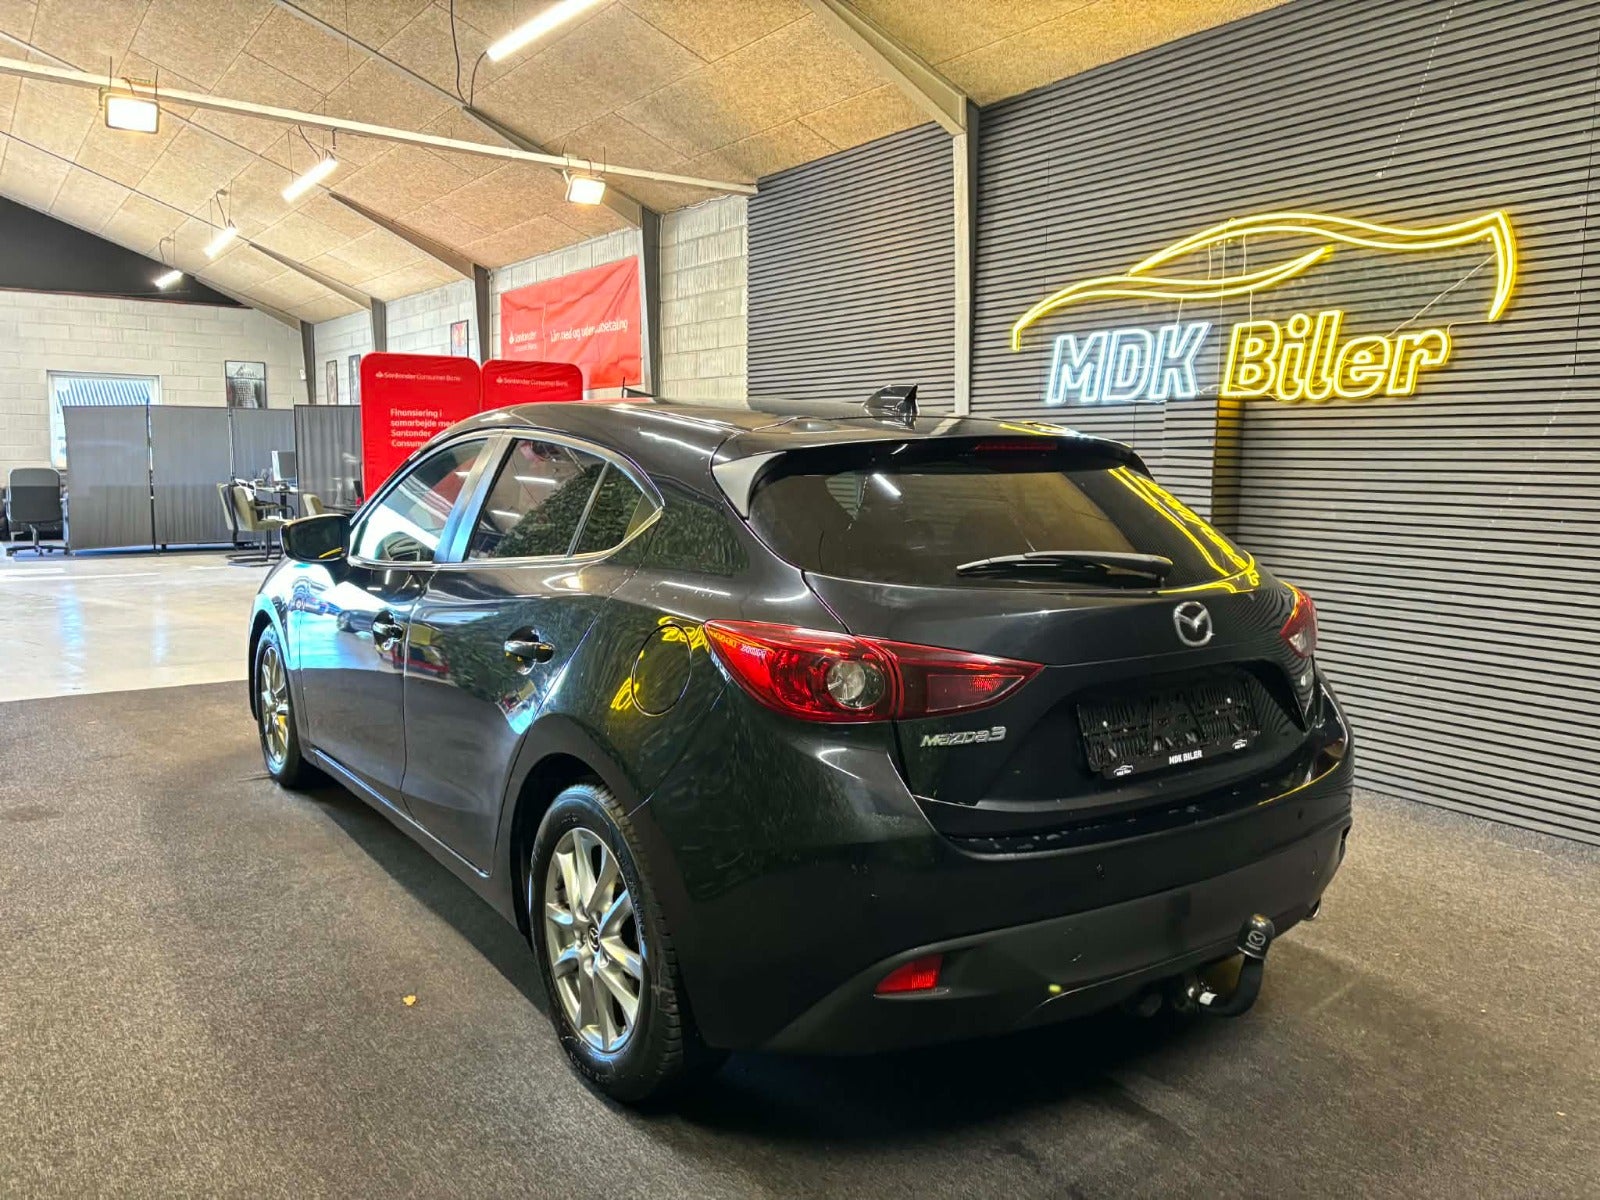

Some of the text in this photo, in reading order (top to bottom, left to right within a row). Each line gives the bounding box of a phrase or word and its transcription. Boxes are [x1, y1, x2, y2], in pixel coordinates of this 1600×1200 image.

[1046, 308, 1452, 404] MDK Biler
[384, 371, 416, 380] Santander
[390, 408, 443, 418] Finansiering i
[390, 419, 437, 428] samarbejde
[390, 429, 432, 437] Santander
[1168, 749, 1203, 765] MDK BILER
